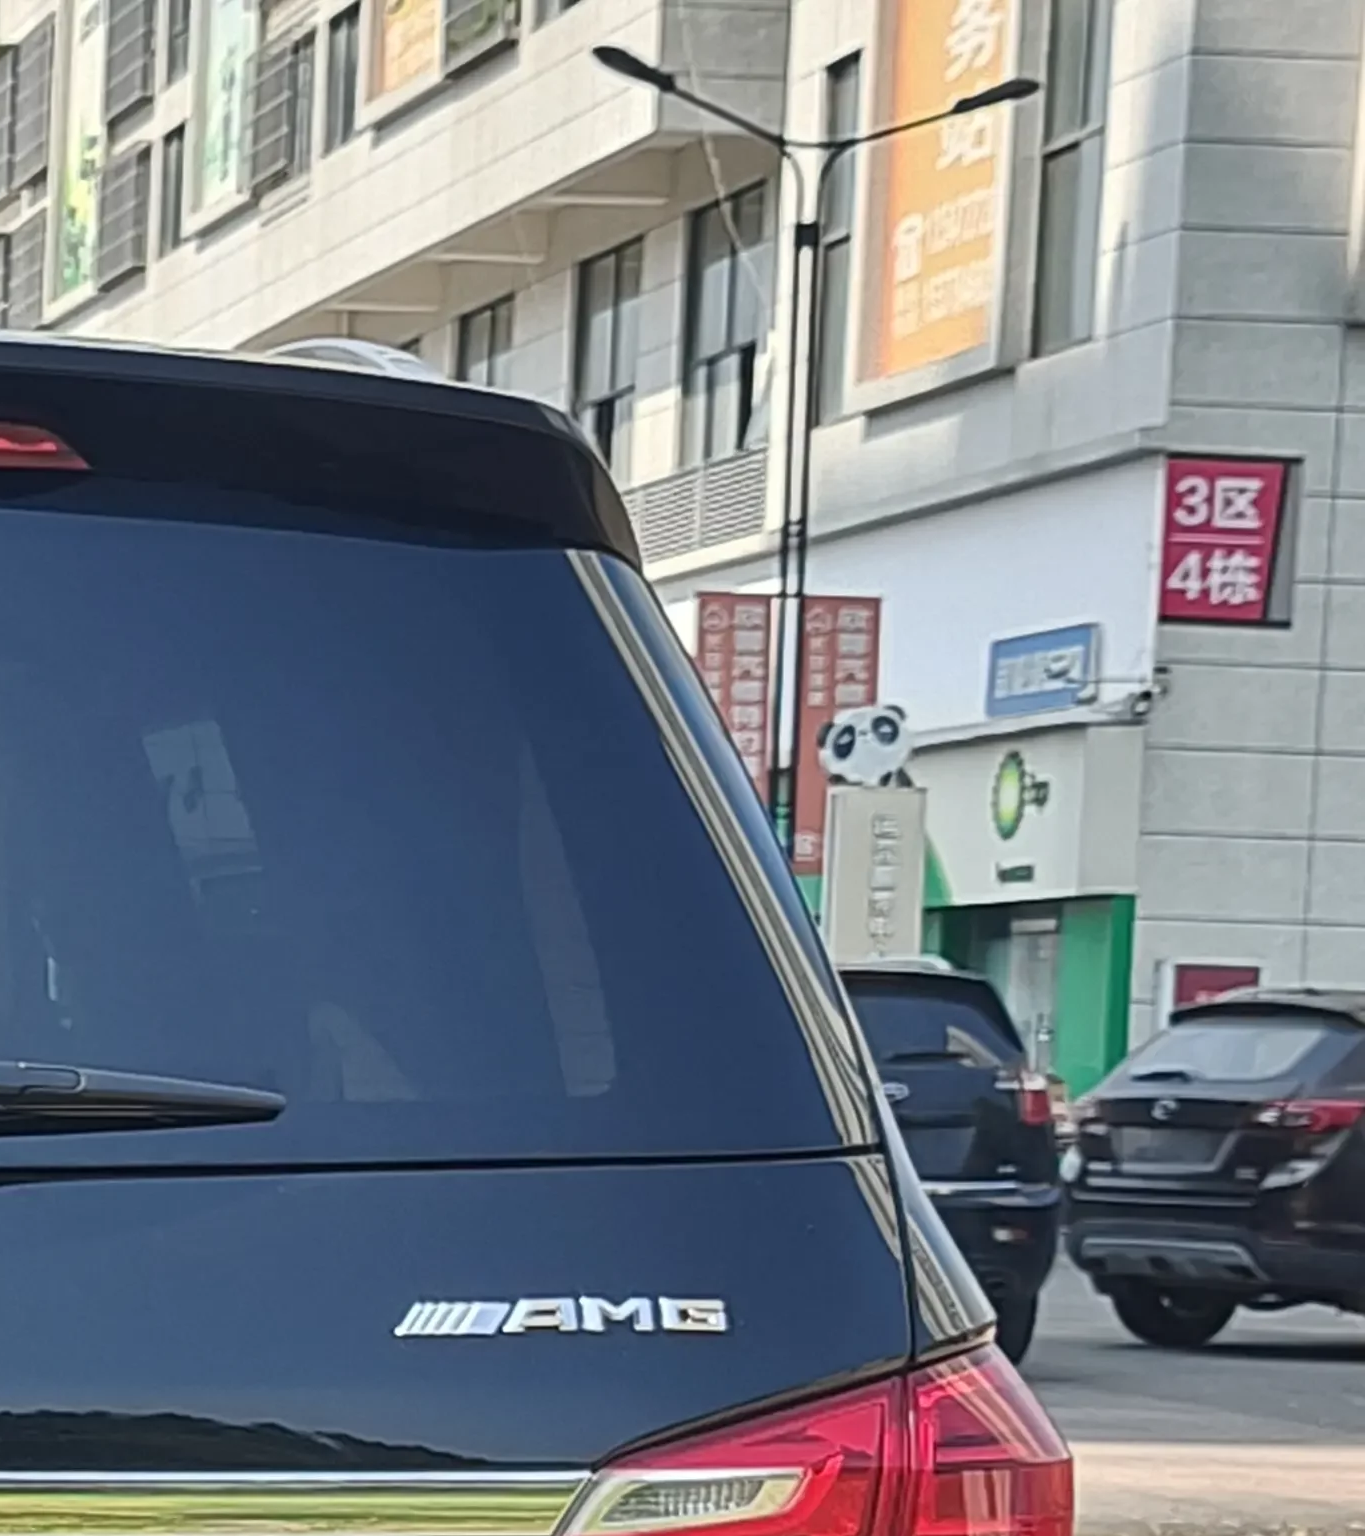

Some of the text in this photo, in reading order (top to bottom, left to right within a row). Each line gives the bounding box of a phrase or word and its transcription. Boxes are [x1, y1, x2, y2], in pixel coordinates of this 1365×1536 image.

[1172, 475, 1265, 529] 3区
[1166, 549, 1262, 606] 4栋
[501, 1295, 729, 1334] AMG
